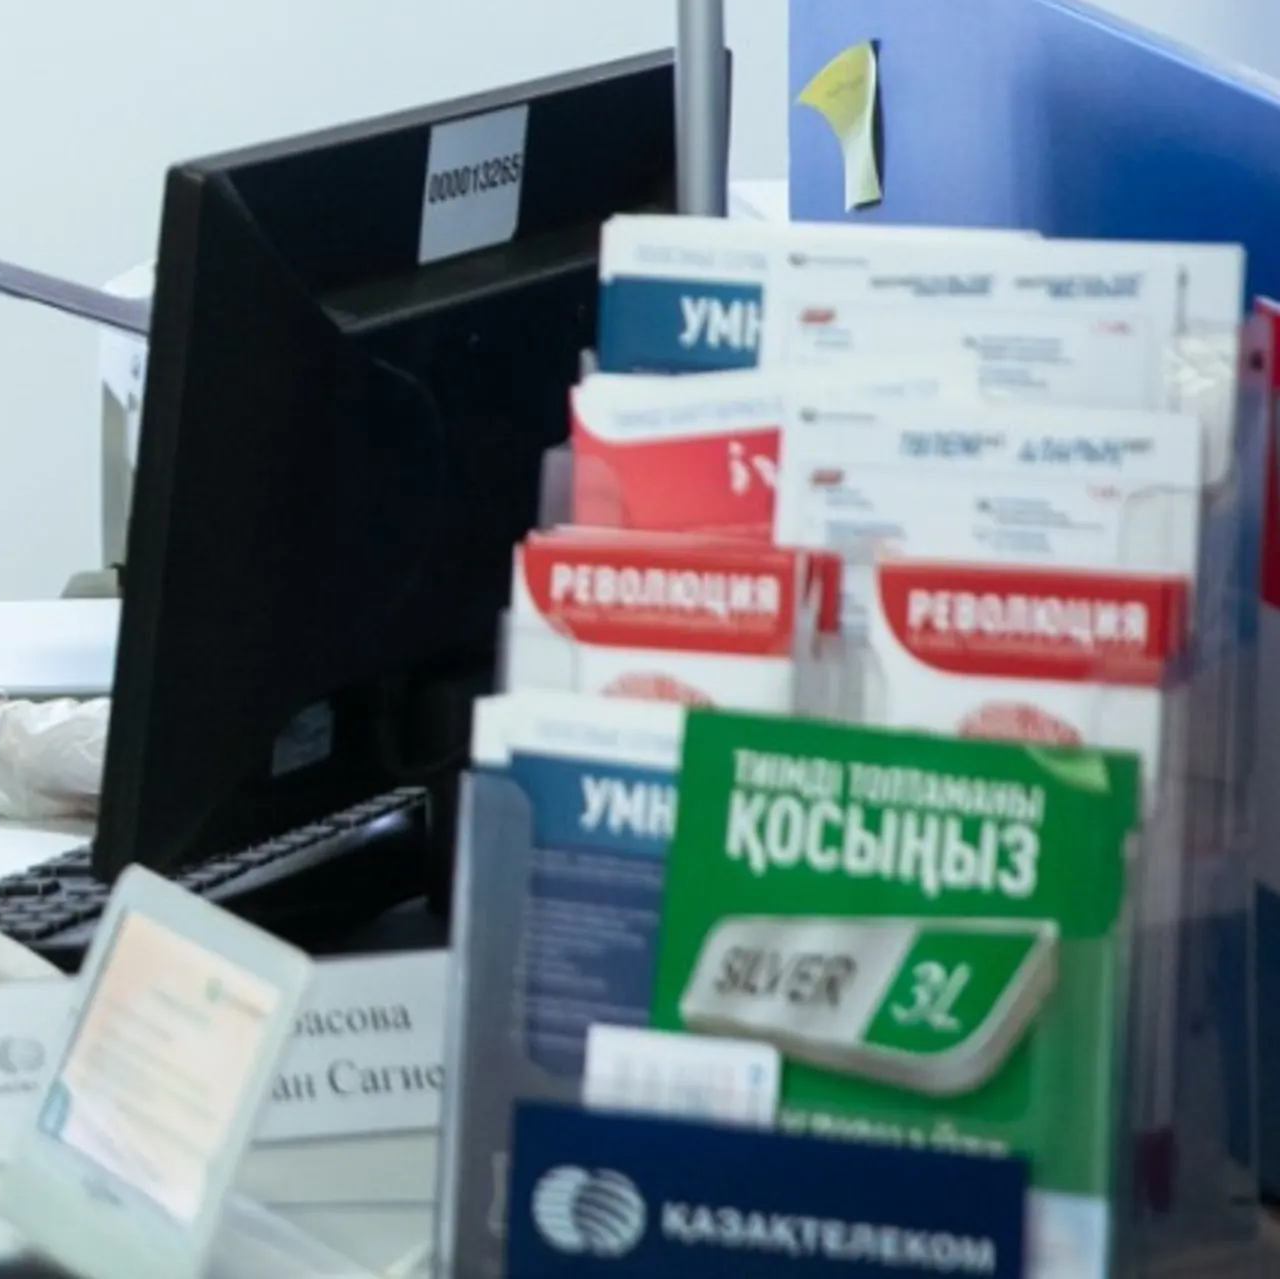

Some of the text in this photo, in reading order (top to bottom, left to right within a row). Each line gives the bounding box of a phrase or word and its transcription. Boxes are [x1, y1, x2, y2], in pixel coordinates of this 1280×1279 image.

[550, 563, 781, 618] РЕВОЛЮЦИЯ
[906, 588, 1149, 652] РЕВОЛЮЦИЯ
[725, 789, 1042, 901] ҚОСЫҢЫЗ
[712, 943, 859, 1009] SILVER
[662, 1200, 998, 1276] ҚАЗАҚТЕЛЕКОМ
